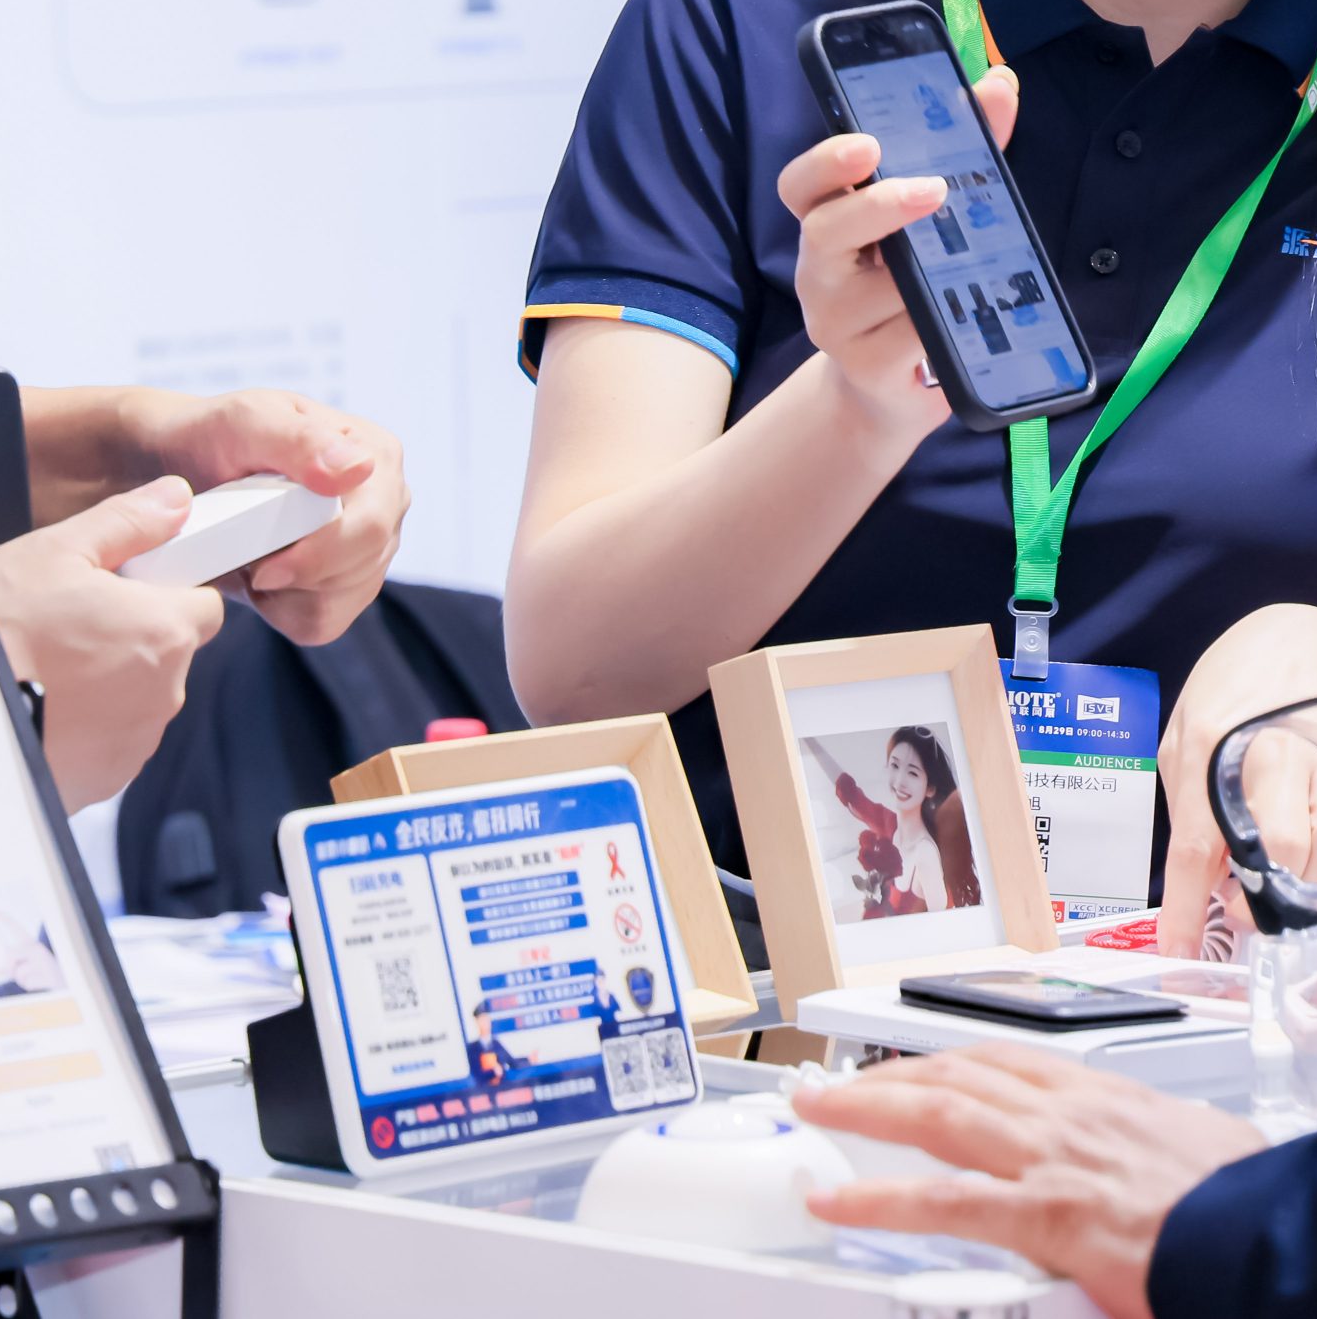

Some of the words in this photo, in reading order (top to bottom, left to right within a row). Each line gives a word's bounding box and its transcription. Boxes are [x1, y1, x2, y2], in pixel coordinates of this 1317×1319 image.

[1038, 726, 1074, 736] 8月29日
[1077, 728, 1130, 739] 09:00-14:30
[1074, 755, 1142, 770] AUDIENCE
